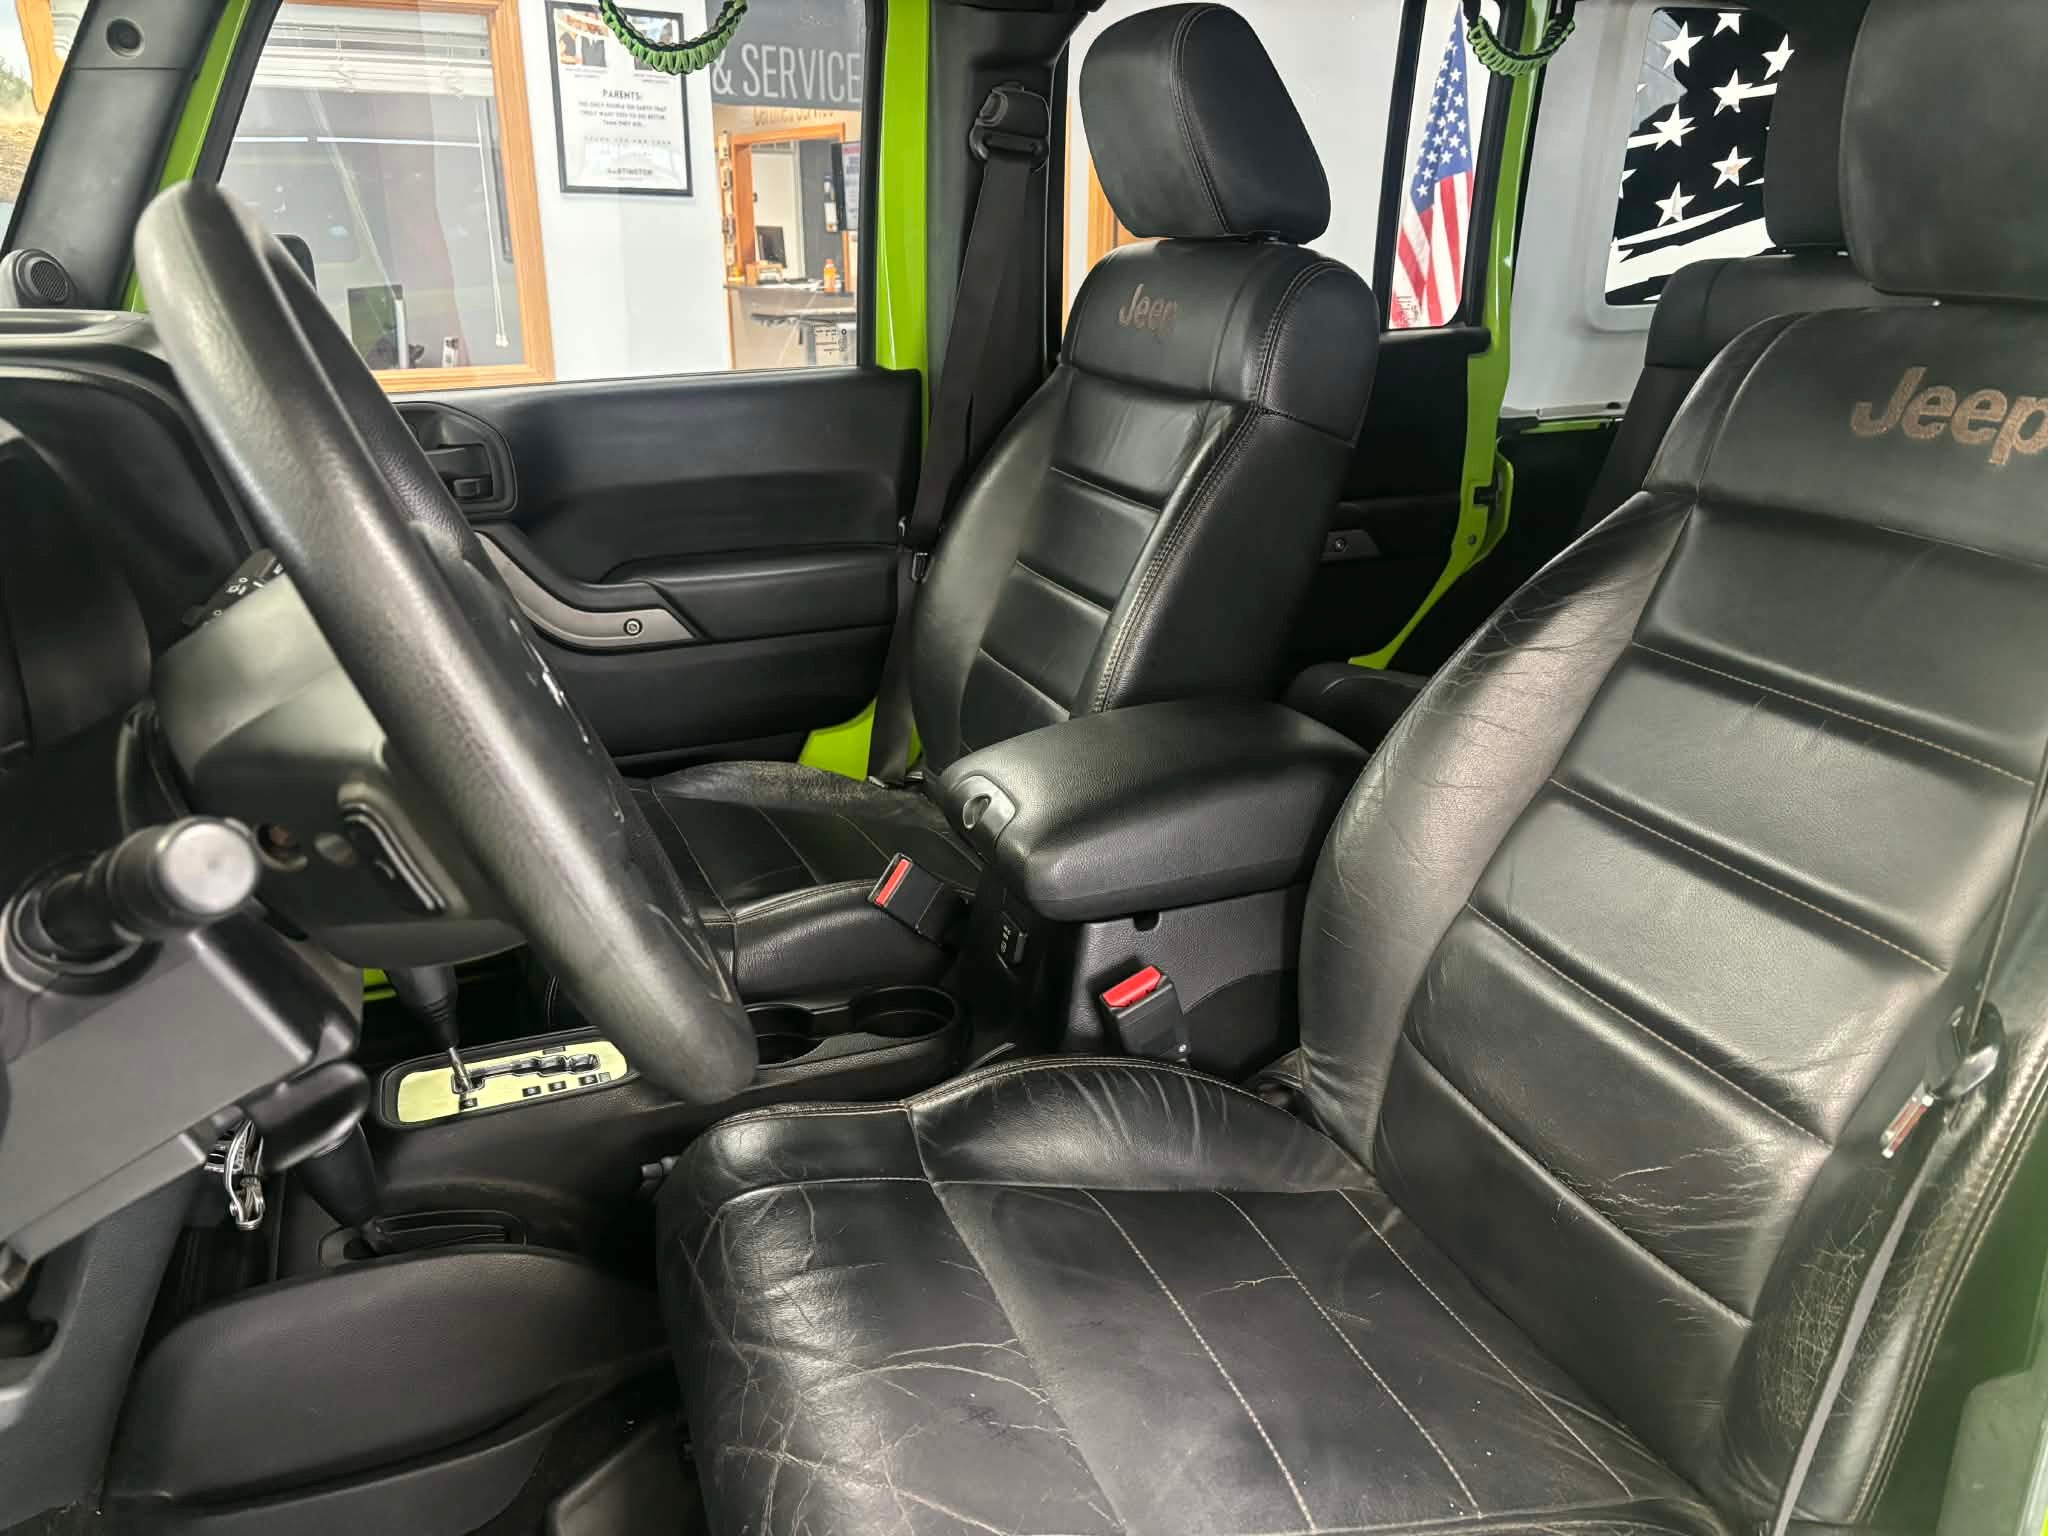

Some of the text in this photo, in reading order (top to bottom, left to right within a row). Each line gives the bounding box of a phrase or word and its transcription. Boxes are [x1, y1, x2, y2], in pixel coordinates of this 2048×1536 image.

[712, 43, 863, 103] & SERVICE
[1119, 283, 1179, 337] Jeep
[1851, 366, 2048, 465] Jeep
